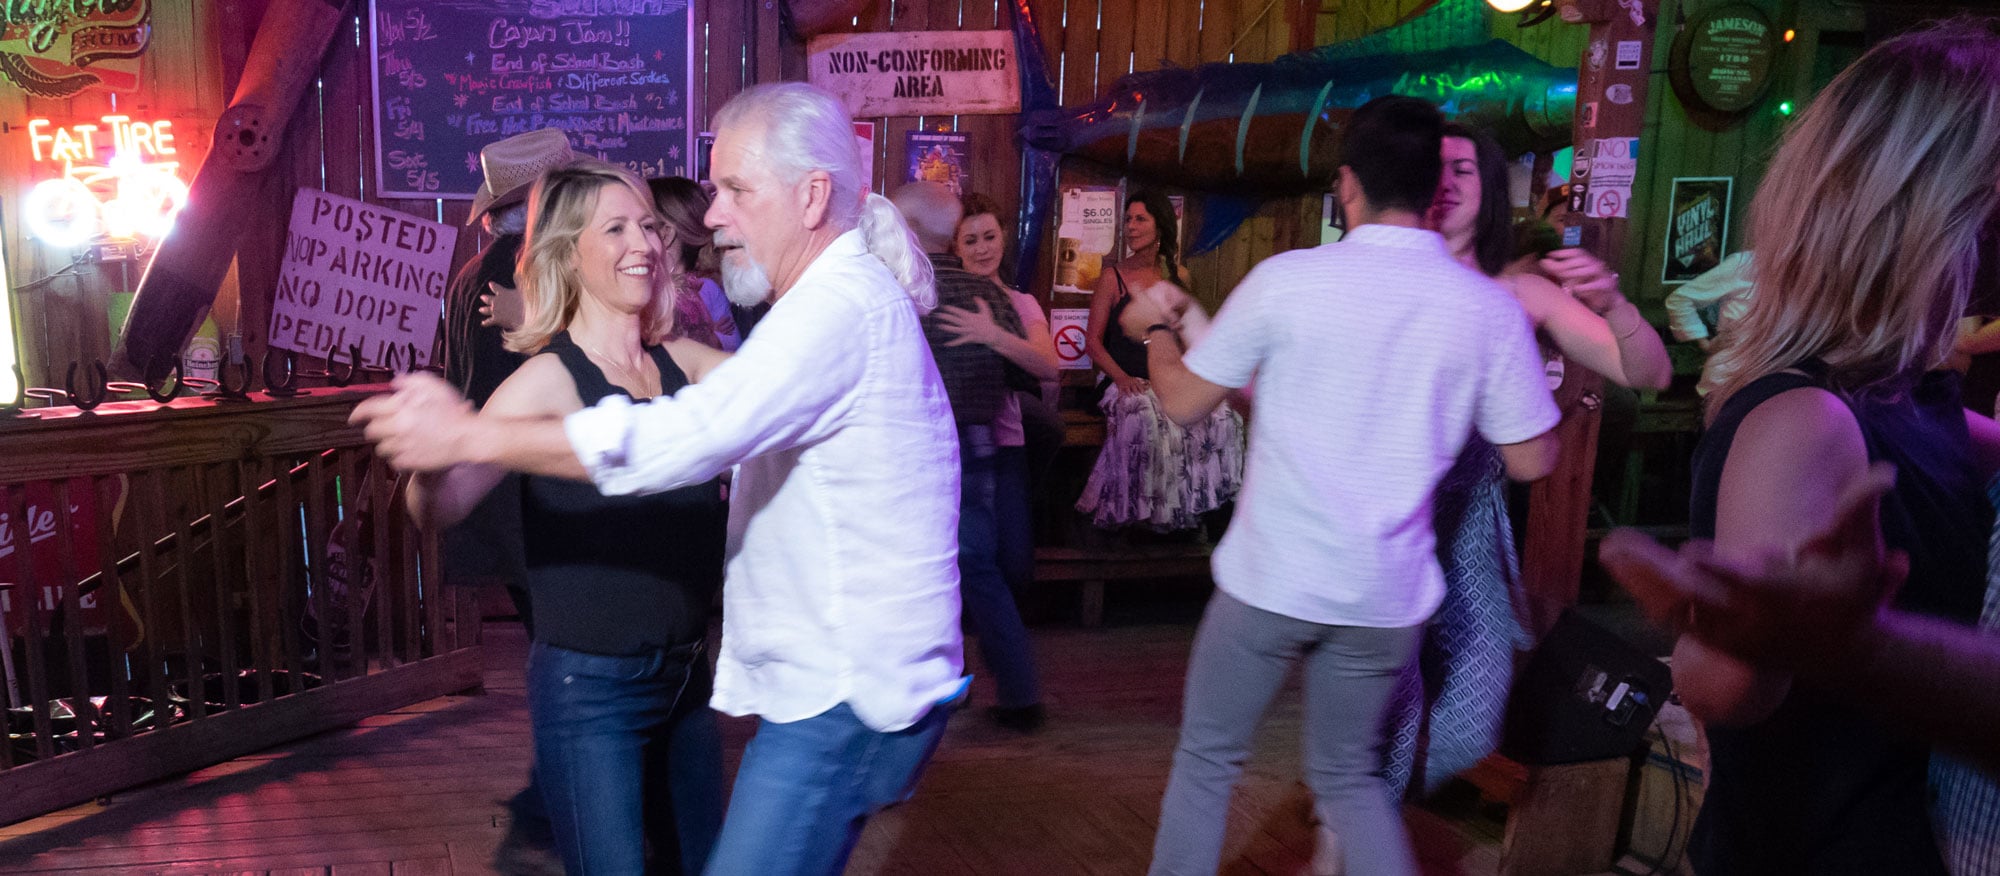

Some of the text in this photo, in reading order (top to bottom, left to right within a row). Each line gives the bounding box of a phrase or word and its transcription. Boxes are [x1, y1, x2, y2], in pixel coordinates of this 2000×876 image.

[488, 17, 557, 49] Cajun
[1707, 17, 1768, 37] JAMESON
[491, 51, 646, 74] End of School Bash
[829, 48, 1006, 74] NON-CONFORMING
[893, 75, 944, 98] AREA
[491, 95, 524, 112] End
[28, 115, 177, 161] FAT TIRE
[1600, 140, 1627, 159] NO
[407, 169, 440, 192] 5/5
[1083, 207, 1113, 218] $6.00
[306, 238, 444, 299] PARKING
[278, 274, 418, 333] NO DOPE
